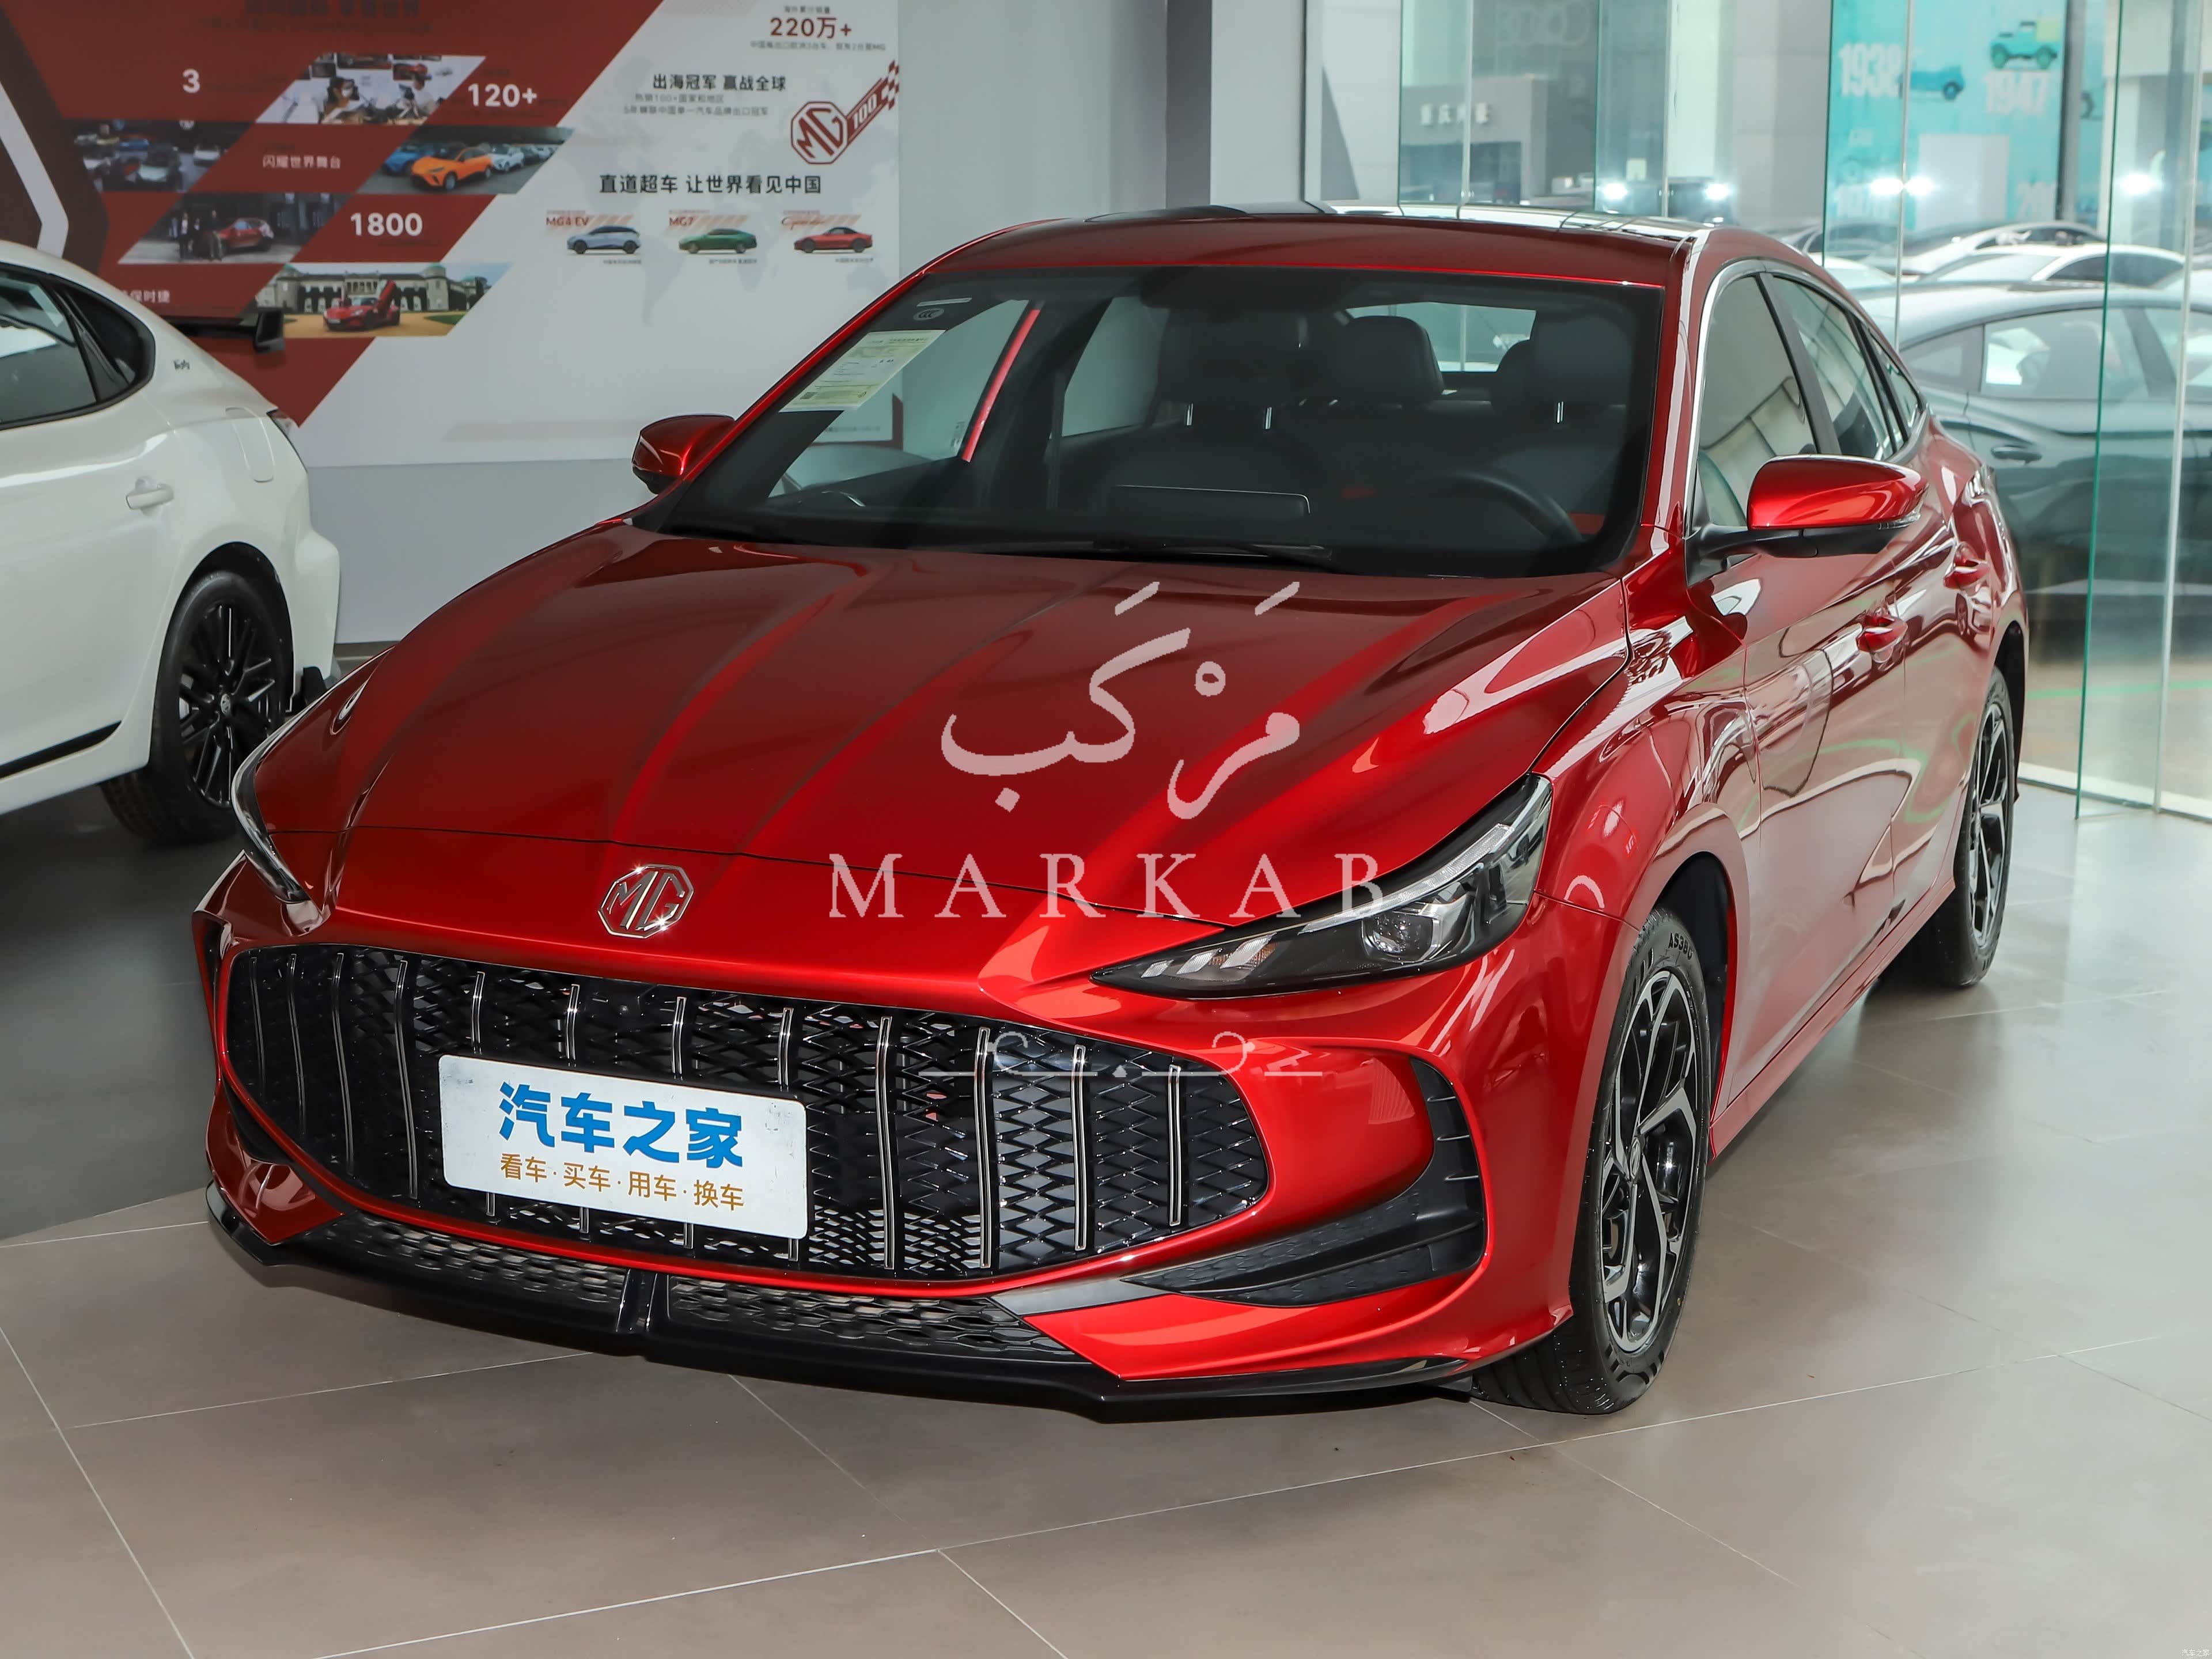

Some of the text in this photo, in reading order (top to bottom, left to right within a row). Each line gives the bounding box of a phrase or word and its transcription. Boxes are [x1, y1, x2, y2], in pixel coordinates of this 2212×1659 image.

[770, 17, 852, 39] 220万+
[182, 69, 200, 93] 3
[653, 73, 786, 92] 出海冠军 赢战全球
[468, 83, 537, 108] 120+
[853, 93, 877, 130] 100
[599, 173, 821, 195] 直道超车 让世界看见中国
[350, 212, 423, 237] 1800
[606, 870, 685, 931] MG
[498, 1080, 743, 1169] 汽车之家
